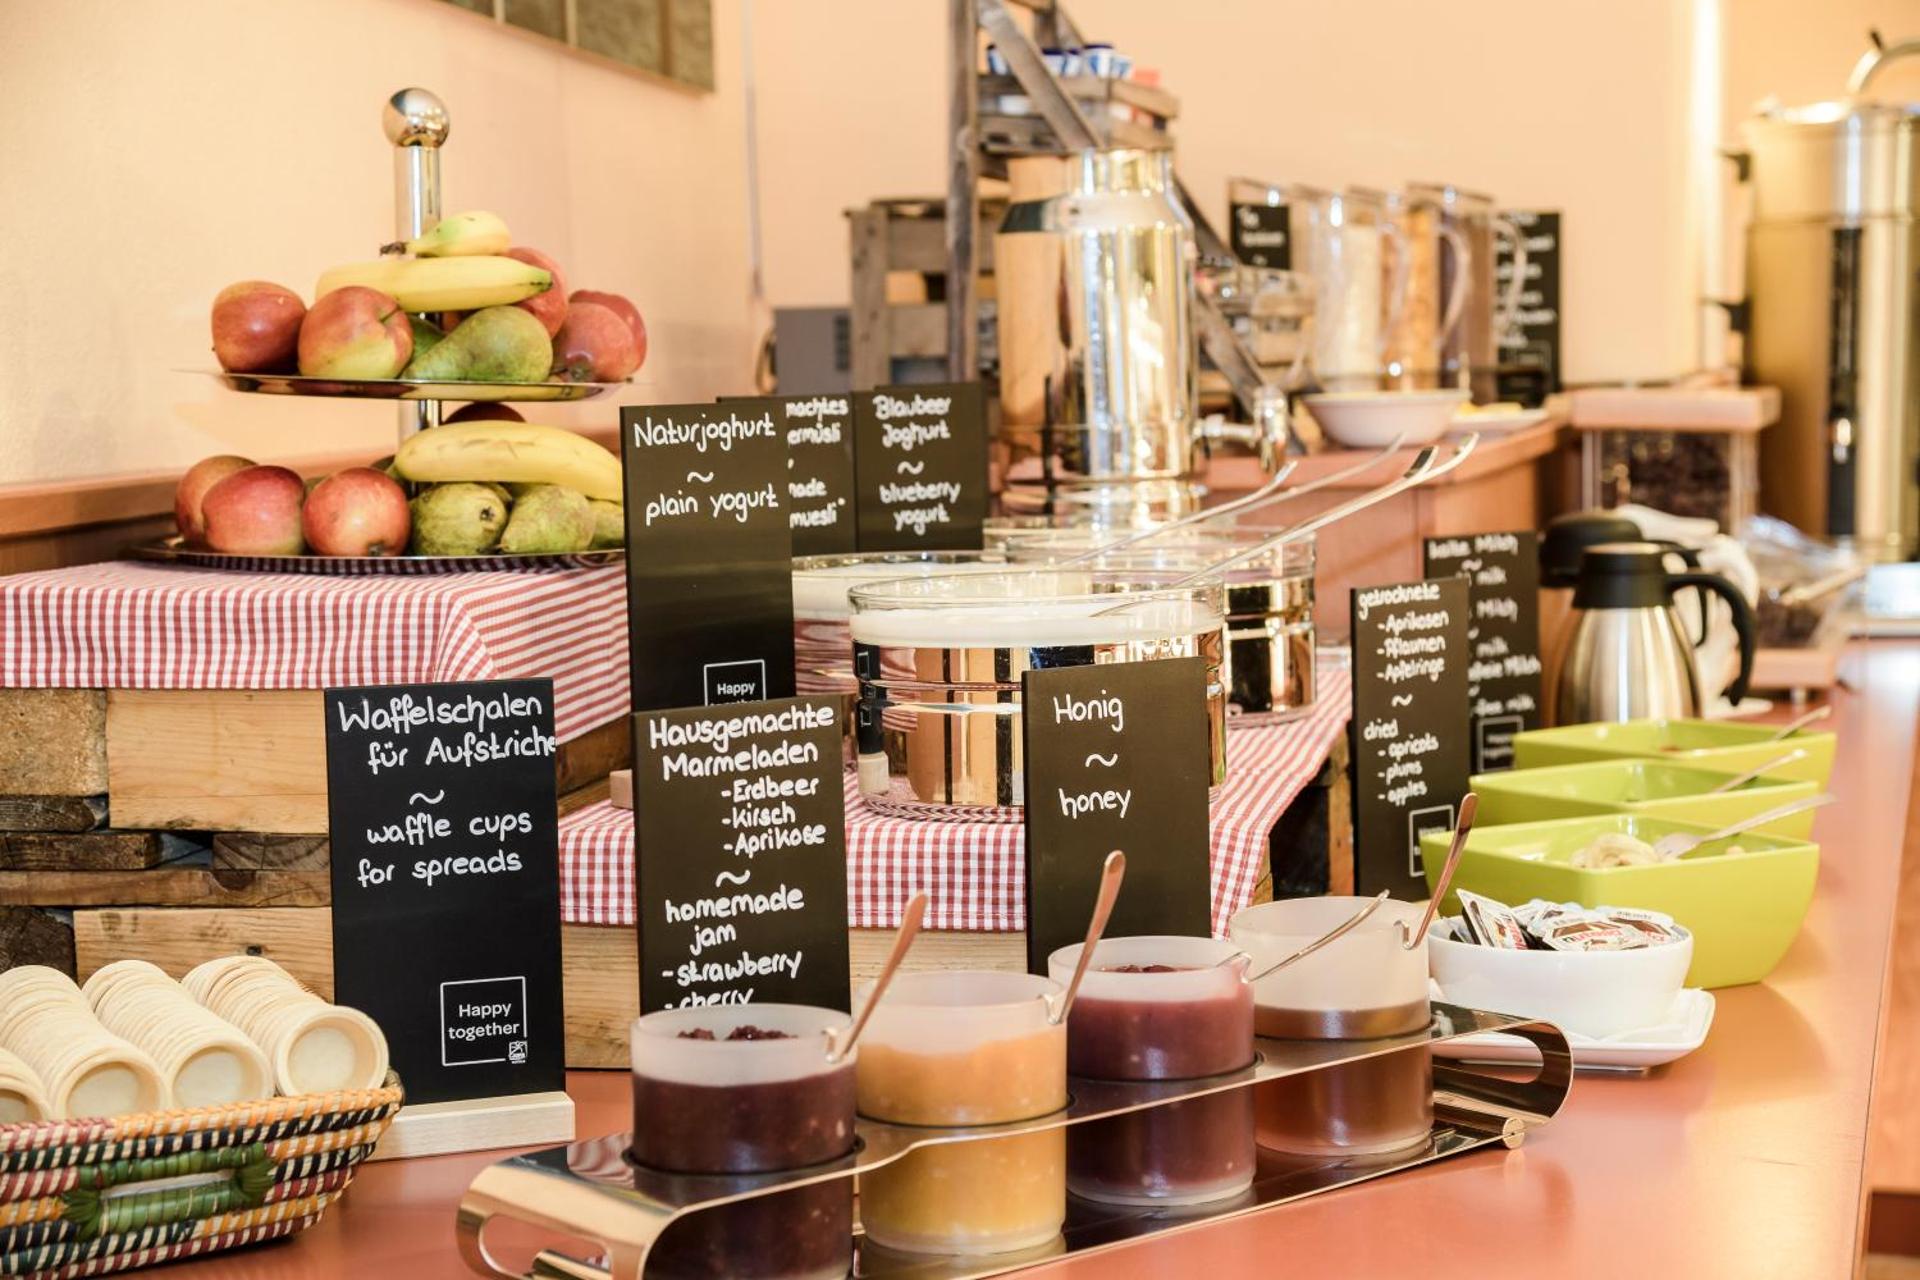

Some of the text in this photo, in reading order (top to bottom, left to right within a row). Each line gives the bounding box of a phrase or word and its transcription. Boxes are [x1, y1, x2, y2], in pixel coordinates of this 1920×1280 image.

[785, 397, 849, 421] machtes
[872, 394, 952, 420] Blaubeer
[634, 412, 776, 452] Naturjoghurt
[787, 420, 842, 444] ermüsli
[881, 419, 951, 450] Joghurt
[646, 482, 779, 527] plain yogurt
[879, 481, 961, 504] blueberry
[893, 502, 951, 536] yogurt
[1358, 582, 1441, 621] getrocknete
[717, 682, 756, 697] Happy
[338, 692, 542, 734] Waffelschalen
[1053, 689, 1123, 732] Honig
[649, 703, 834, 753] Hausgemachte
[1363, 718, 1399, 741] dried
[368, 725, 557, 775] für Aufstriche
[662, 739, 818, 781] Marmeladen
[1058, 787, 1131, 819] honey
[367, 812, 533, 846] waffle cups
[357, 849, 523, 888] for spreads
[665, 883, 805, 923] homemade
[689, 924, 736, 956] jam
[458, 1003, 512, 1020] Happy
[448, 1022, 520, 1042] together
